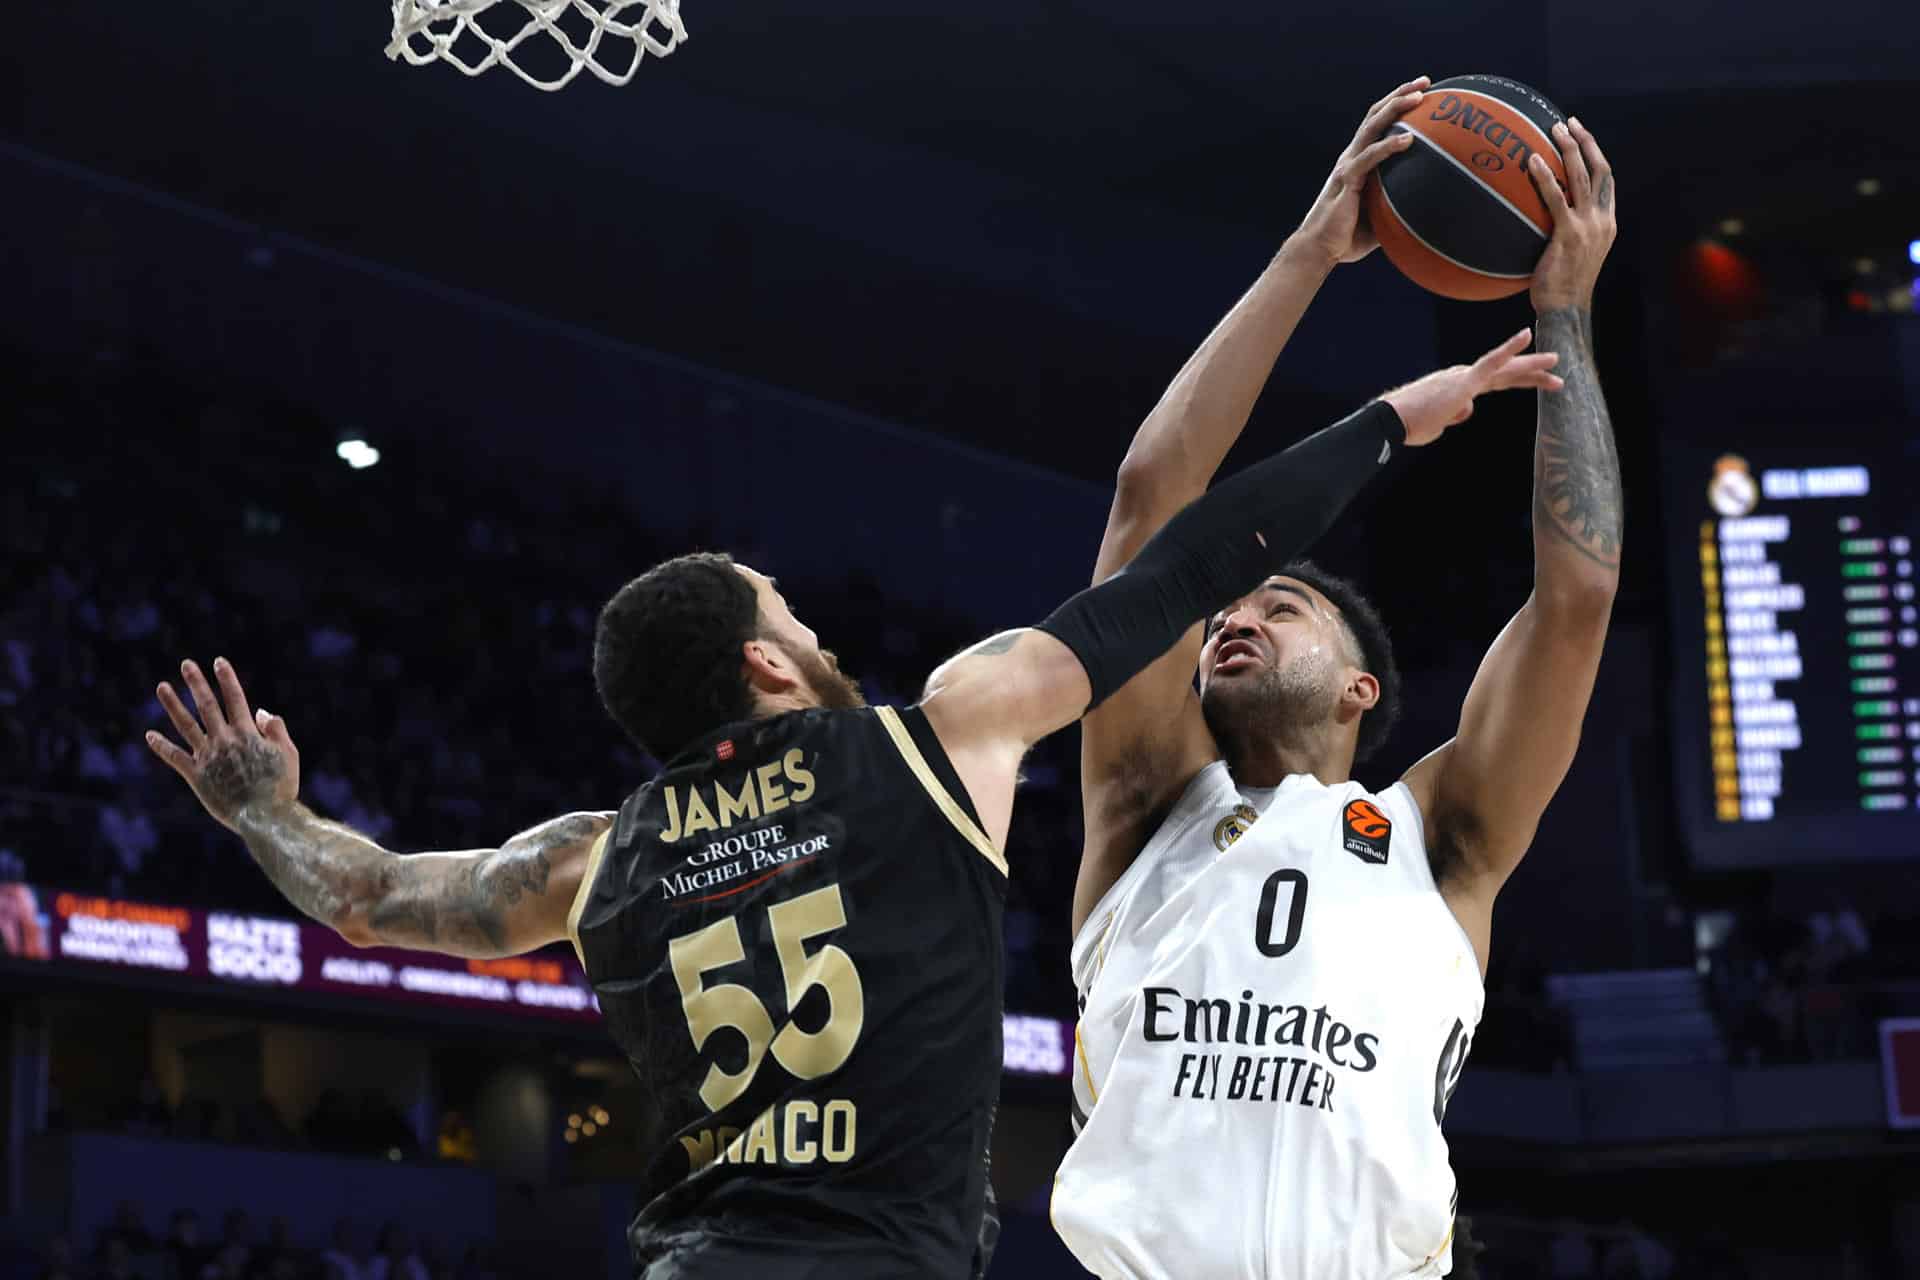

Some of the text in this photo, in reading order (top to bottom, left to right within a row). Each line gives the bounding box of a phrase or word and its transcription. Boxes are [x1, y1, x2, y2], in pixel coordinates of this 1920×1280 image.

[1430, 94, 1537, 173] ALDING
[659, 748, 816, 843] JAMES
[660, 834, 831, 900] MICHEL PASTOR
[686, 824, 787, 867] GROUPE
[1255, 868, 1309, 958] 0
[668, 882, 865, 1113] 55
[1143, 986, 1379, 1073] Emirates
[1173, 1053, 1335, 1113] FLY BETTER
